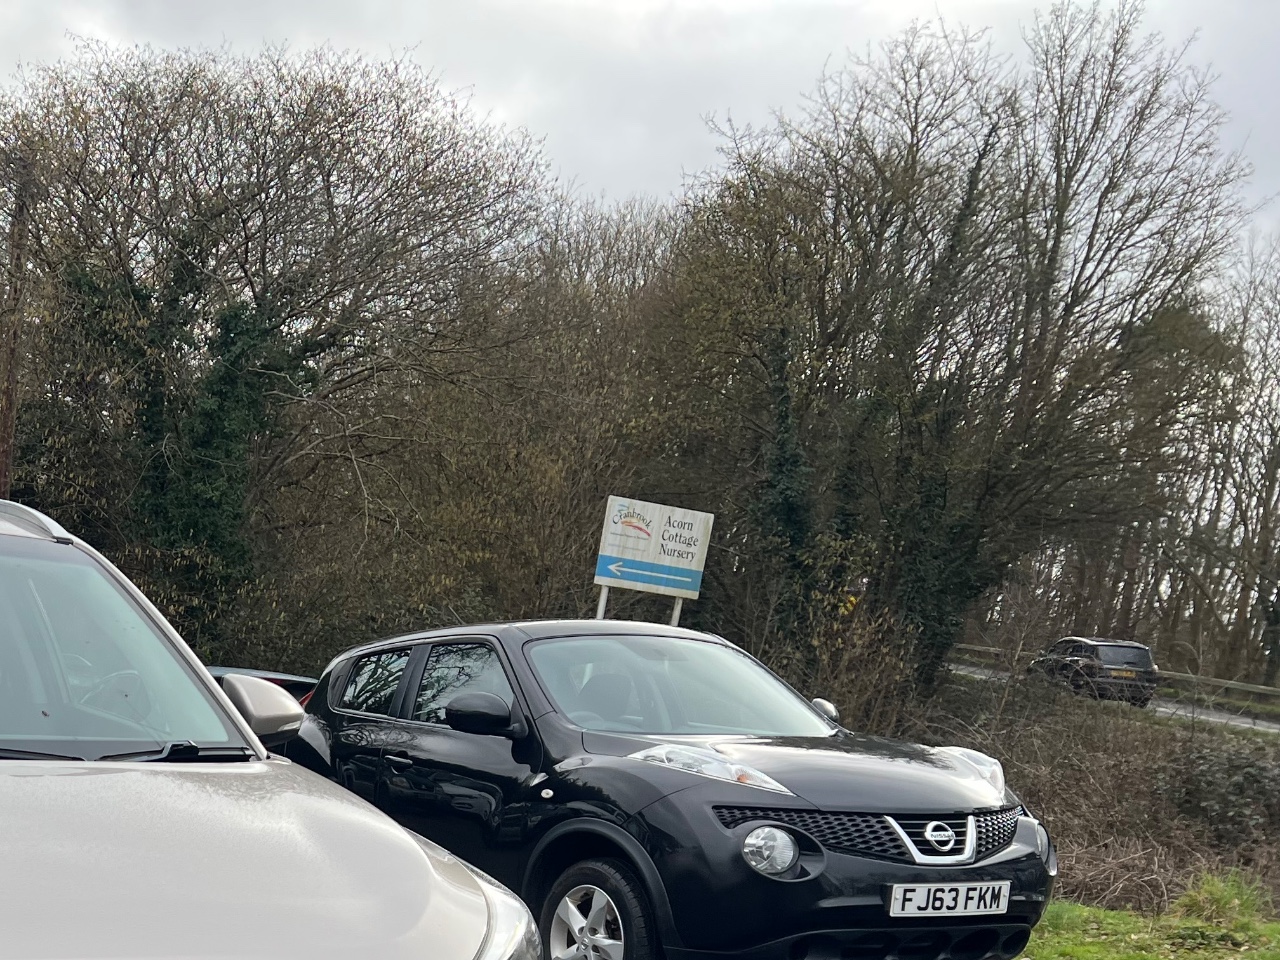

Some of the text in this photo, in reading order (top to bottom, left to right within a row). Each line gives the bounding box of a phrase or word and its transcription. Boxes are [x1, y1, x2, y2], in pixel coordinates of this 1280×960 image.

[613, 508, 652, 529] Cranbrook
[663, 515, 694, 532] Acorn
[661, 529, 699, 547] Cottage
[658, 543, 696, 562] Nursery
[901, 886, 1002, 911] FJ63 FKM
